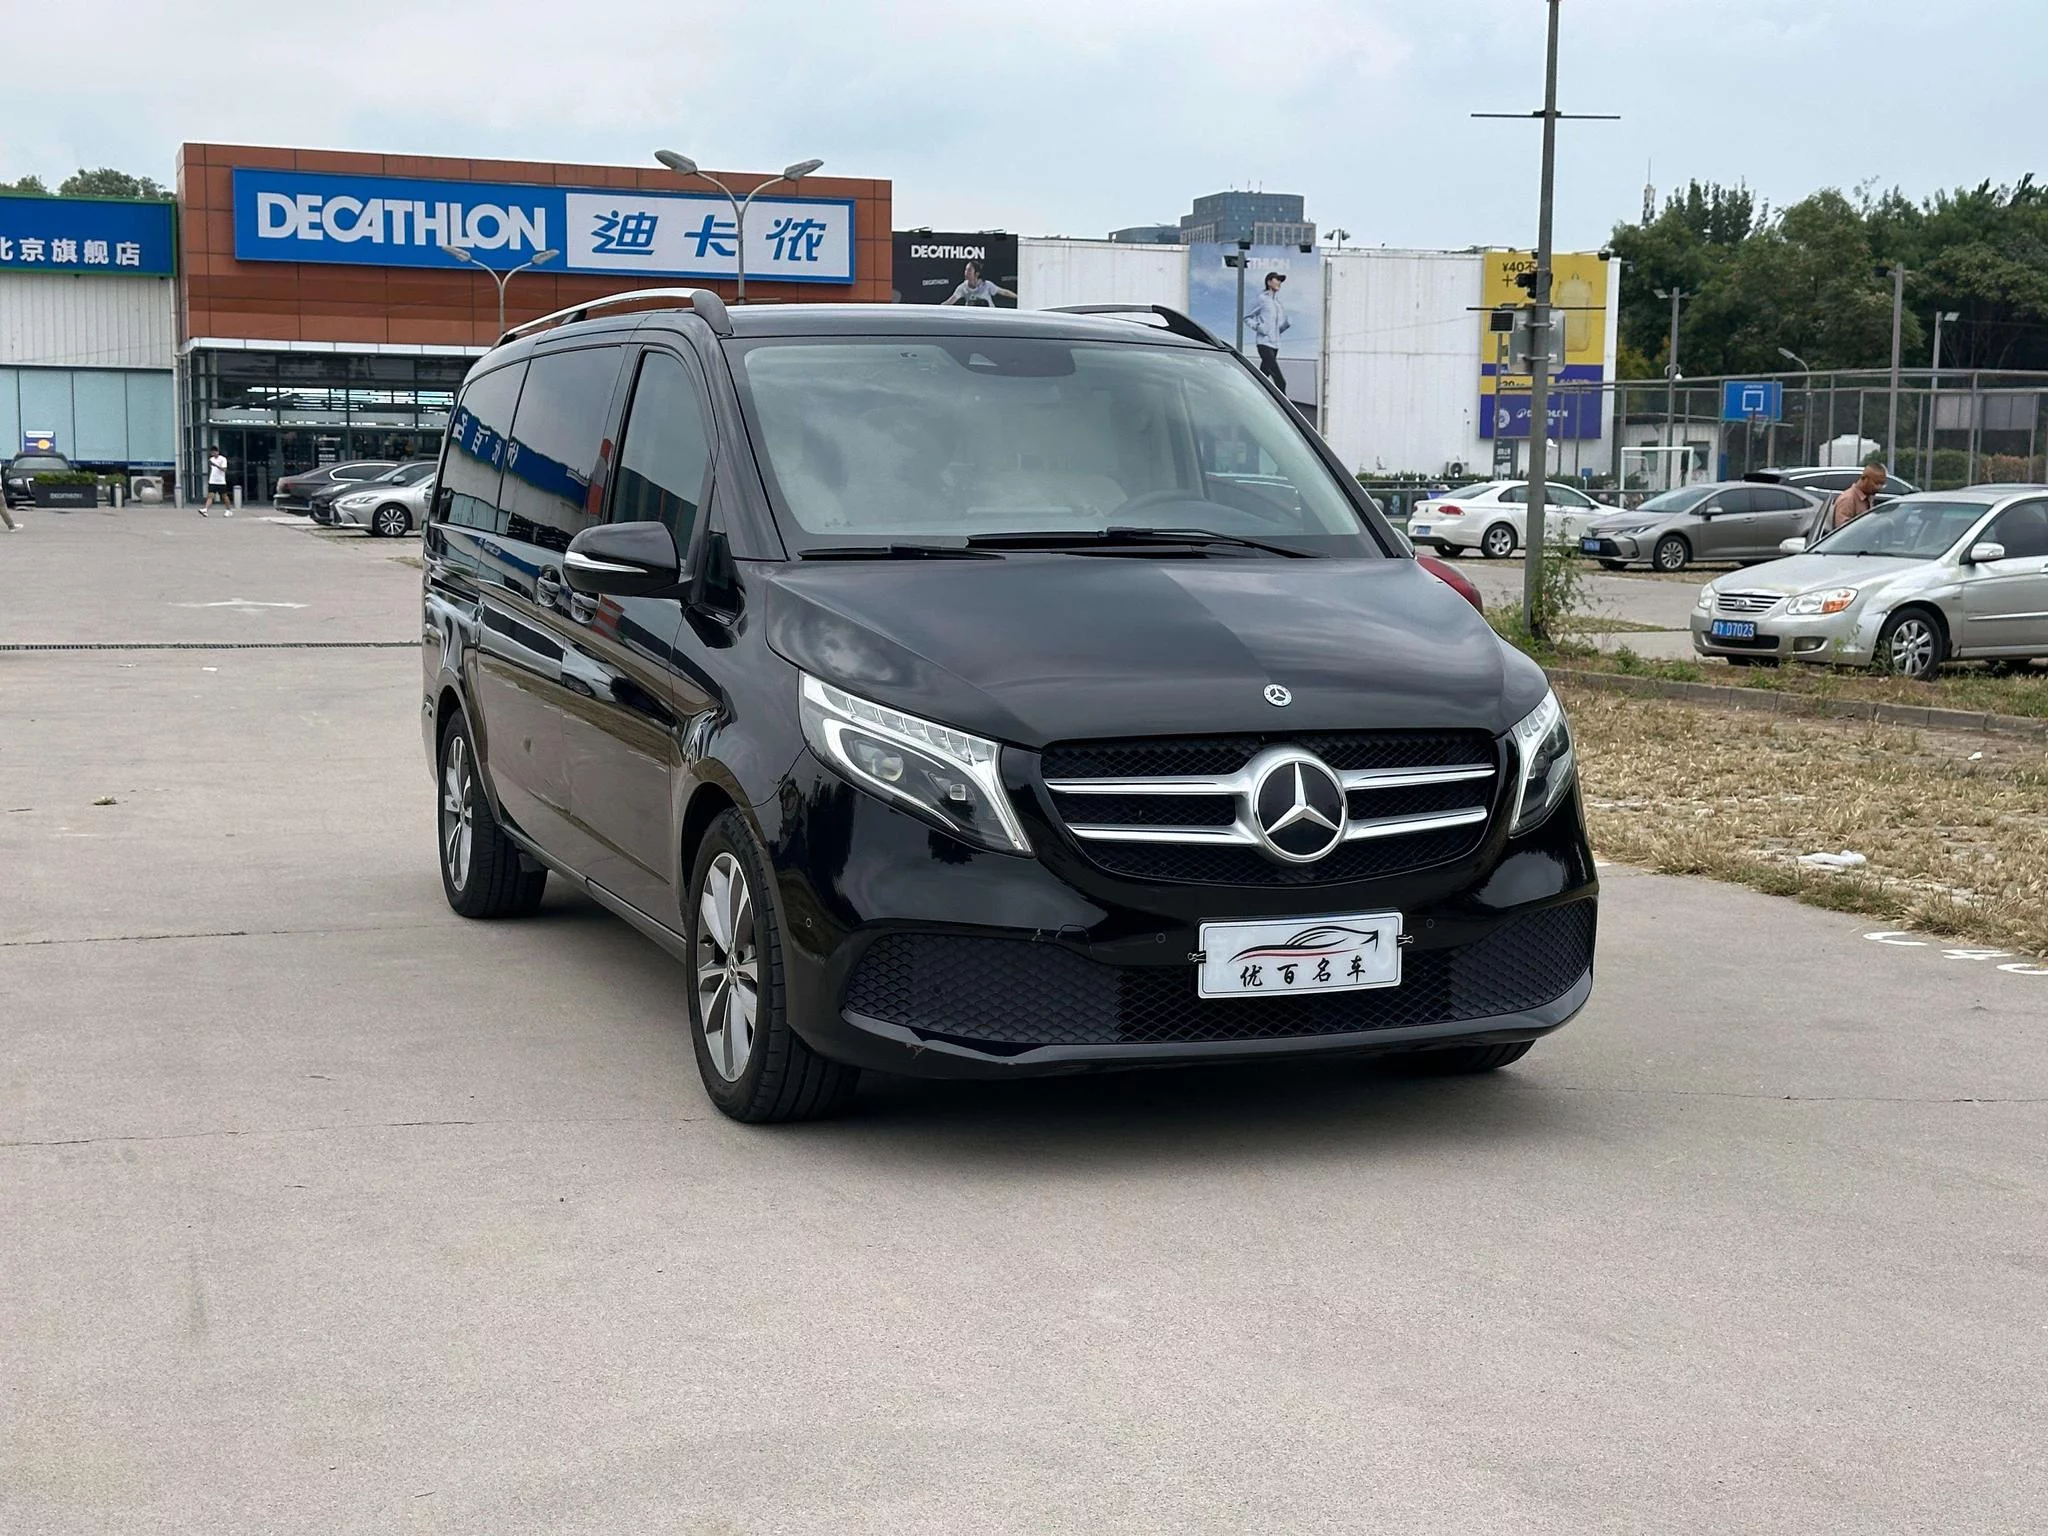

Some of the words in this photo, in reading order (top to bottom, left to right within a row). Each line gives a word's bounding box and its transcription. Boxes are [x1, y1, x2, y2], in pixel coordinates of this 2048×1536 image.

[257, 192, 546, 250] DECATHLON
[591, 210, 826, 262] 迪卡侬
[911, 245, 985, 259] DECATHLON
[1240, 955, 1366, 987] 优百名车
